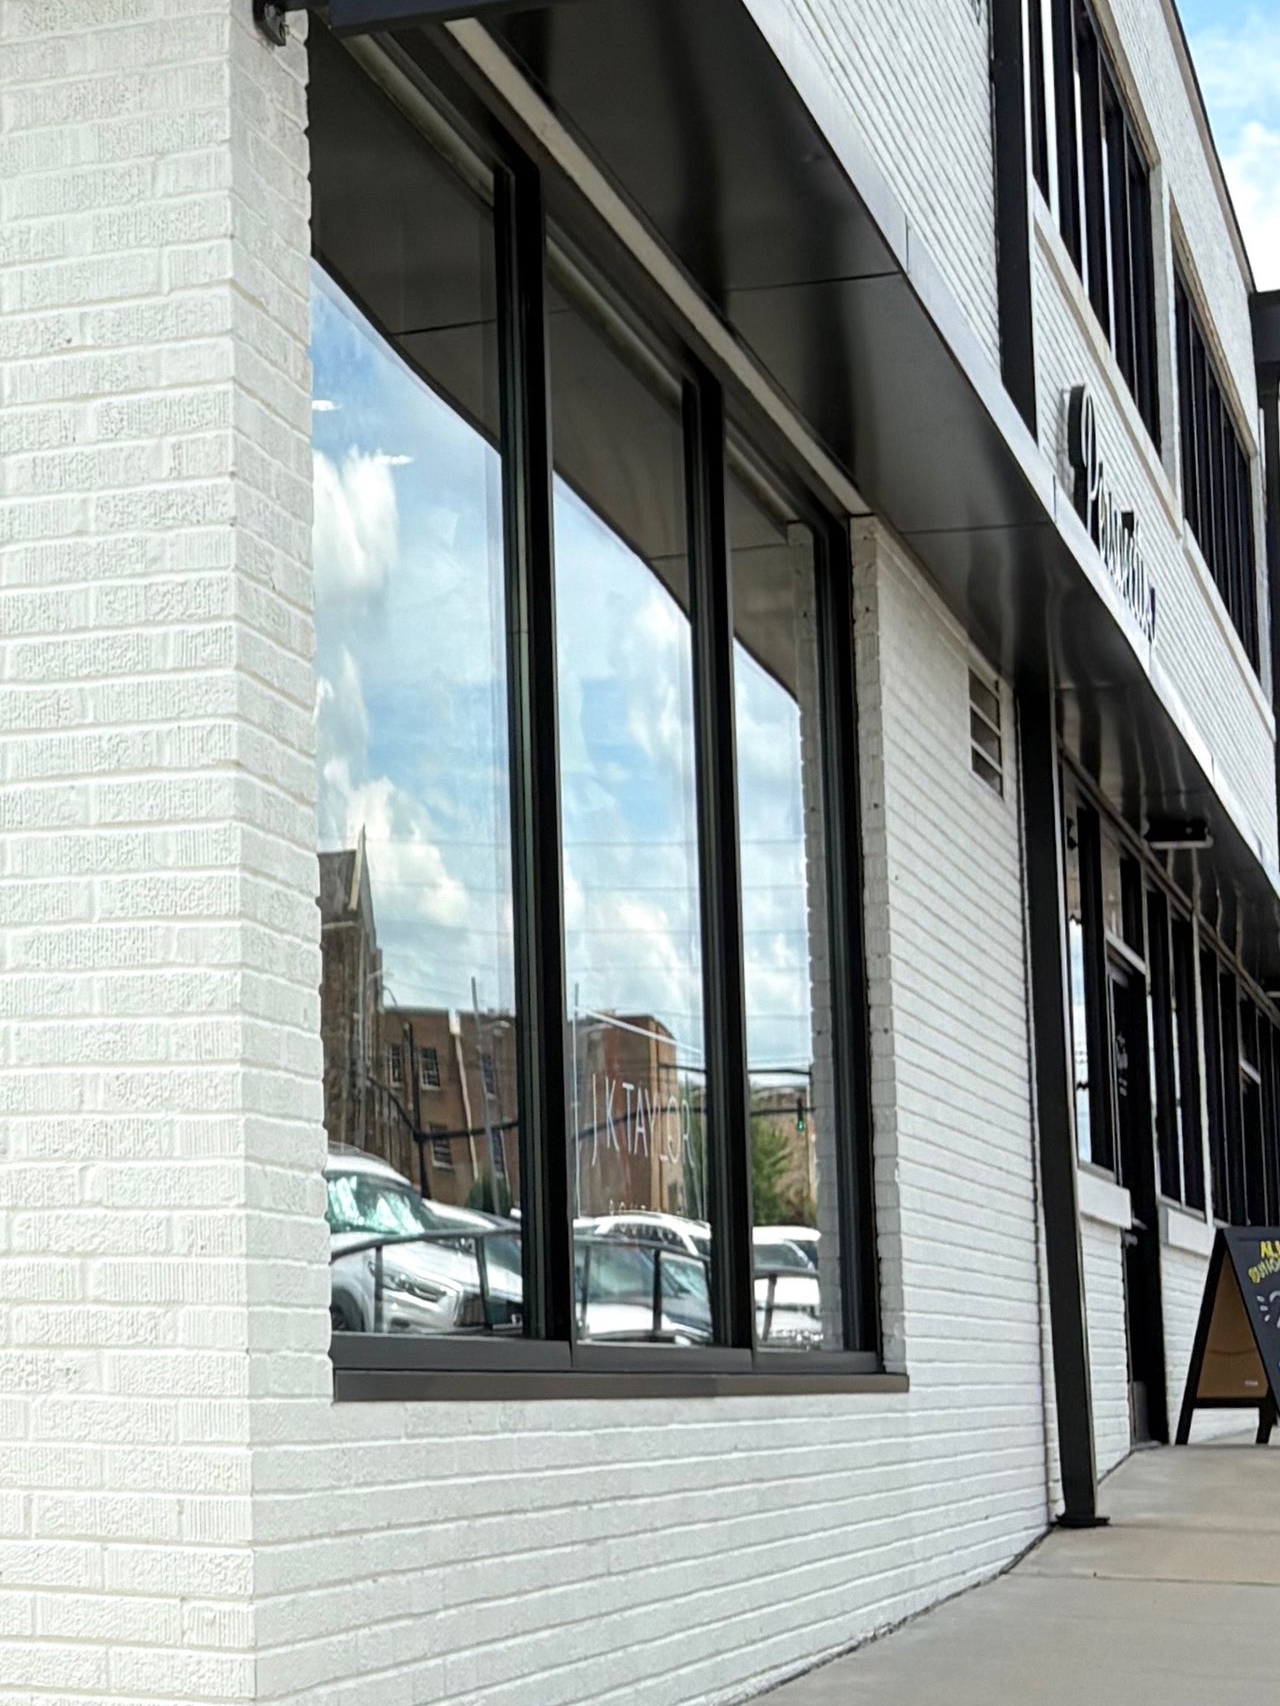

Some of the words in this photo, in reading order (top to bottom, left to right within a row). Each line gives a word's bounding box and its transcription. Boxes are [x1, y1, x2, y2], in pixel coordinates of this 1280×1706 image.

[592, 1072, 599, 1166] J
[605, 1075, 621, 1152] K
[622, 1081, 696, 1169] TAYLOR
